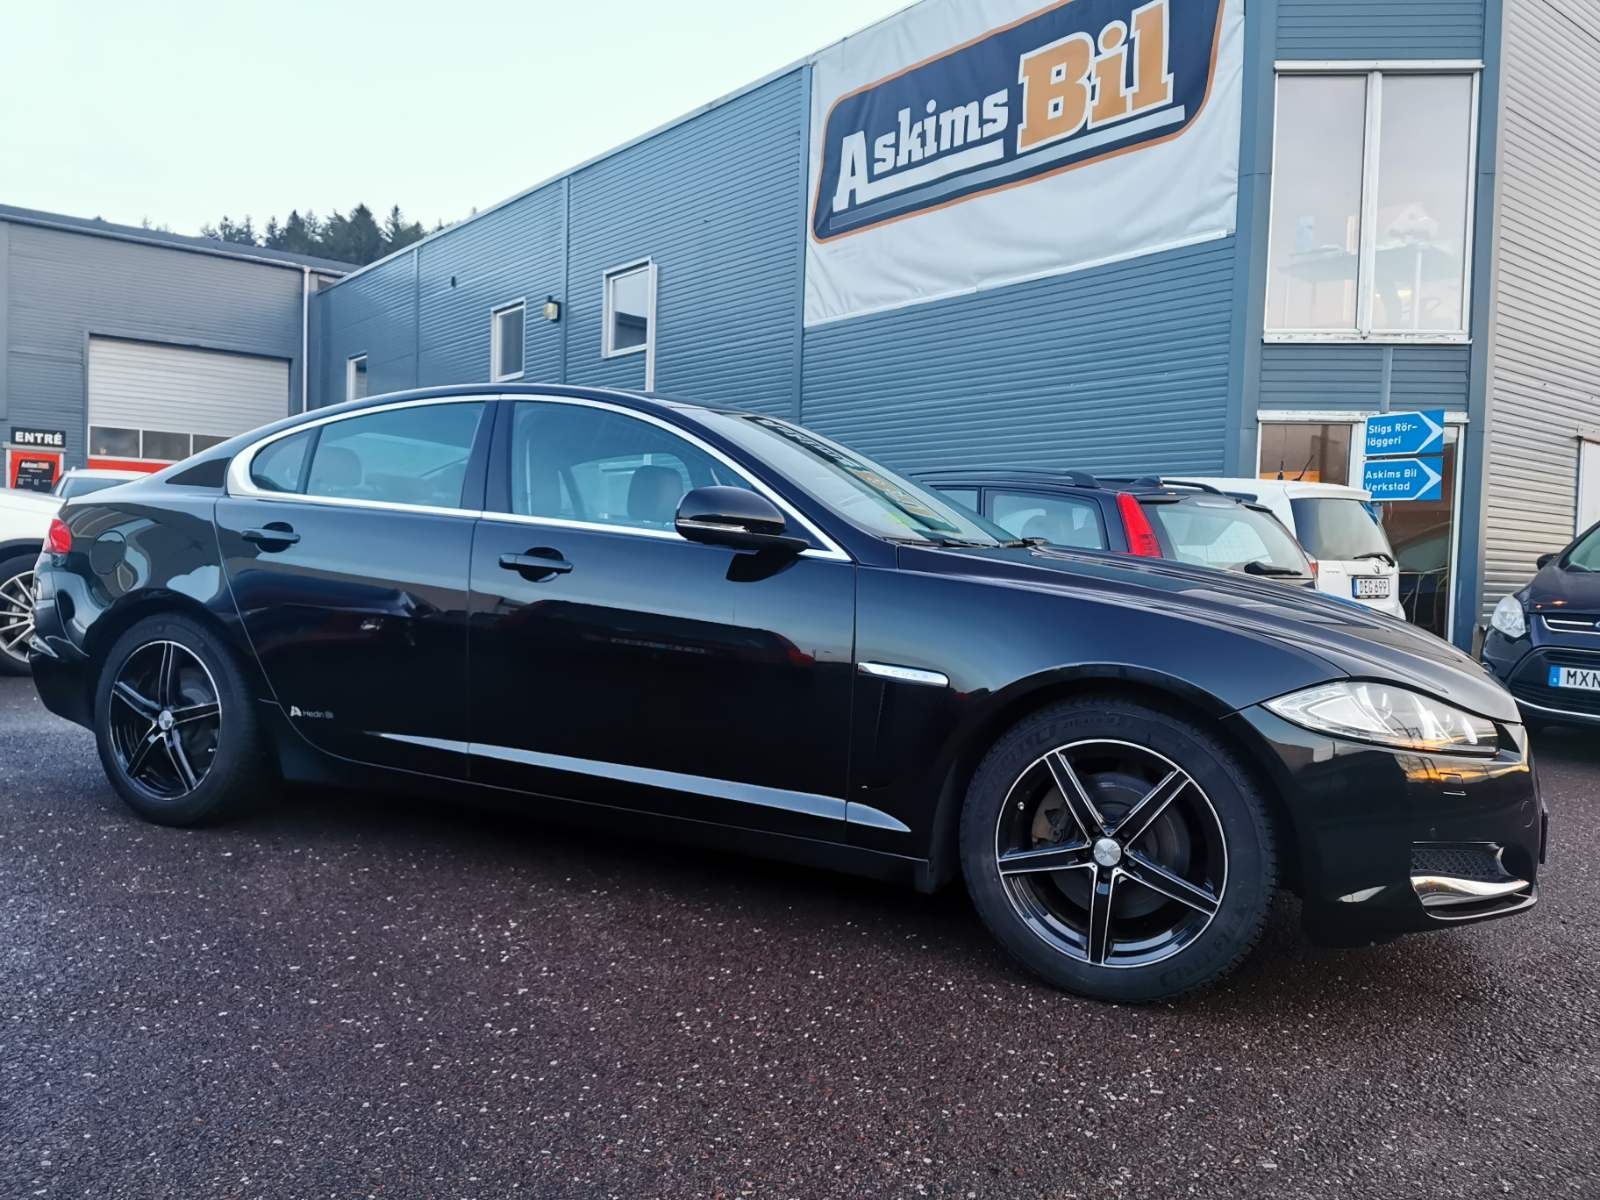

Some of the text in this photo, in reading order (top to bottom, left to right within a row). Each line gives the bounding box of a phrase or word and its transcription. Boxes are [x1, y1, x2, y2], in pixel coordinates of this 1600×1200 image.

[832, 0, 1175, 213] Askims Bil
[1368, 424, 1392, 435] Stigs
[15, 431, 63, 445] ENTRÉ
[1367, 436, 1401, 448] läggeri
[1365, 468, 1417, 479] Askims Bil
[1365, 482, 1410, 491] Verkstad
[1567, 670, 1600, 688] MXN
